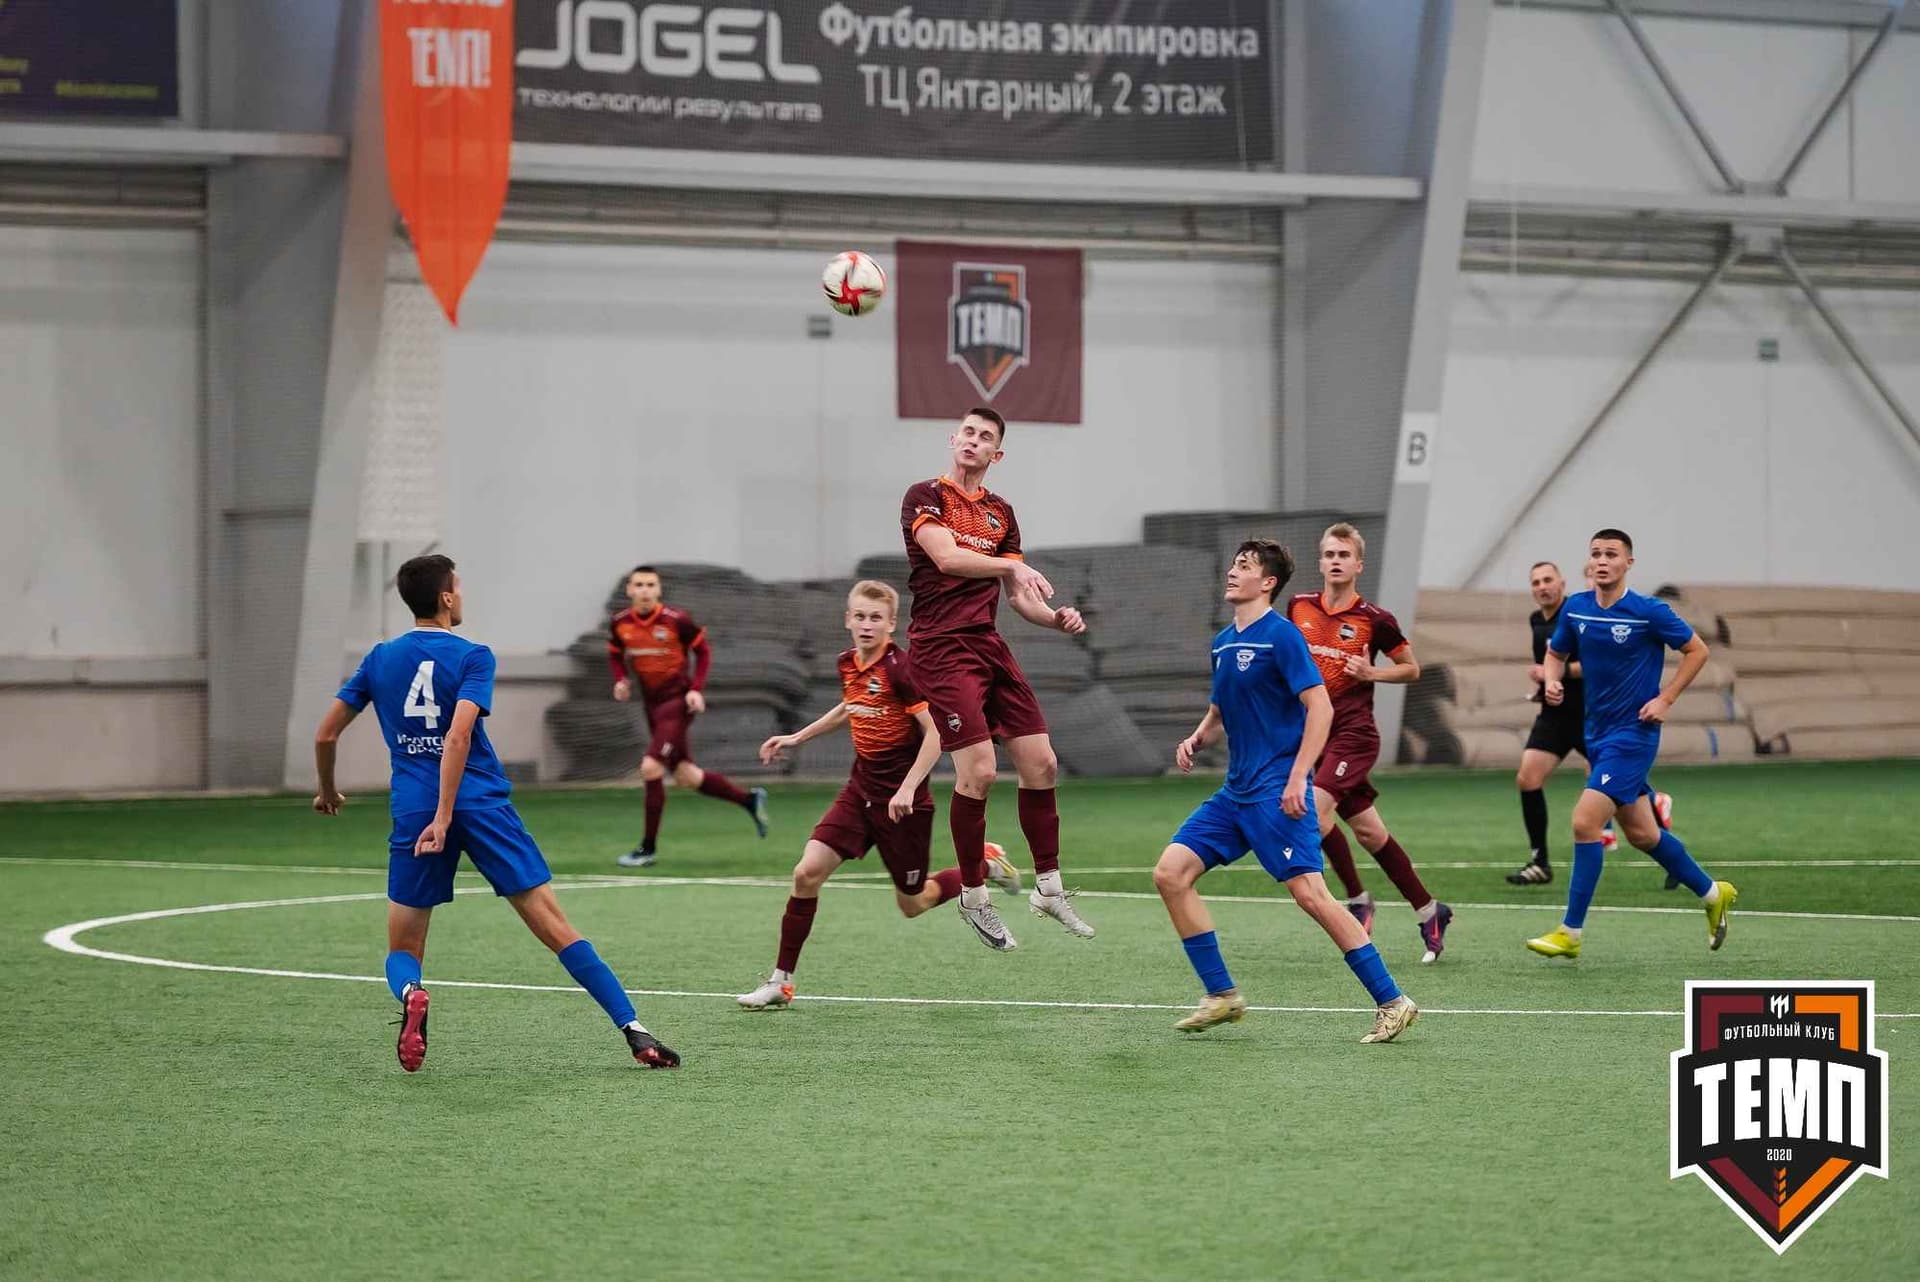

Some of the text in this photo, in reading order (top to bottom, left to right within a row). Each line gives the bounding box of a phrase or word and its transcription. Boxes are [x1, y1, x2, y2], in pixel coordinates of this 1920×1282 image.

[515, 0, 822, 83] JOGEL
[818, 3, 1259, 66] Футбольная экипировка
[517, 87, 822, 123] технологии результата
[857, 64, 1226, 121] ТЦ Янтарный, 2 этаж
[956, 301, 1022, 350] ТЕМП
[404, 660, 441, 729] 4
[1335, 761, 1348, 777] 6
